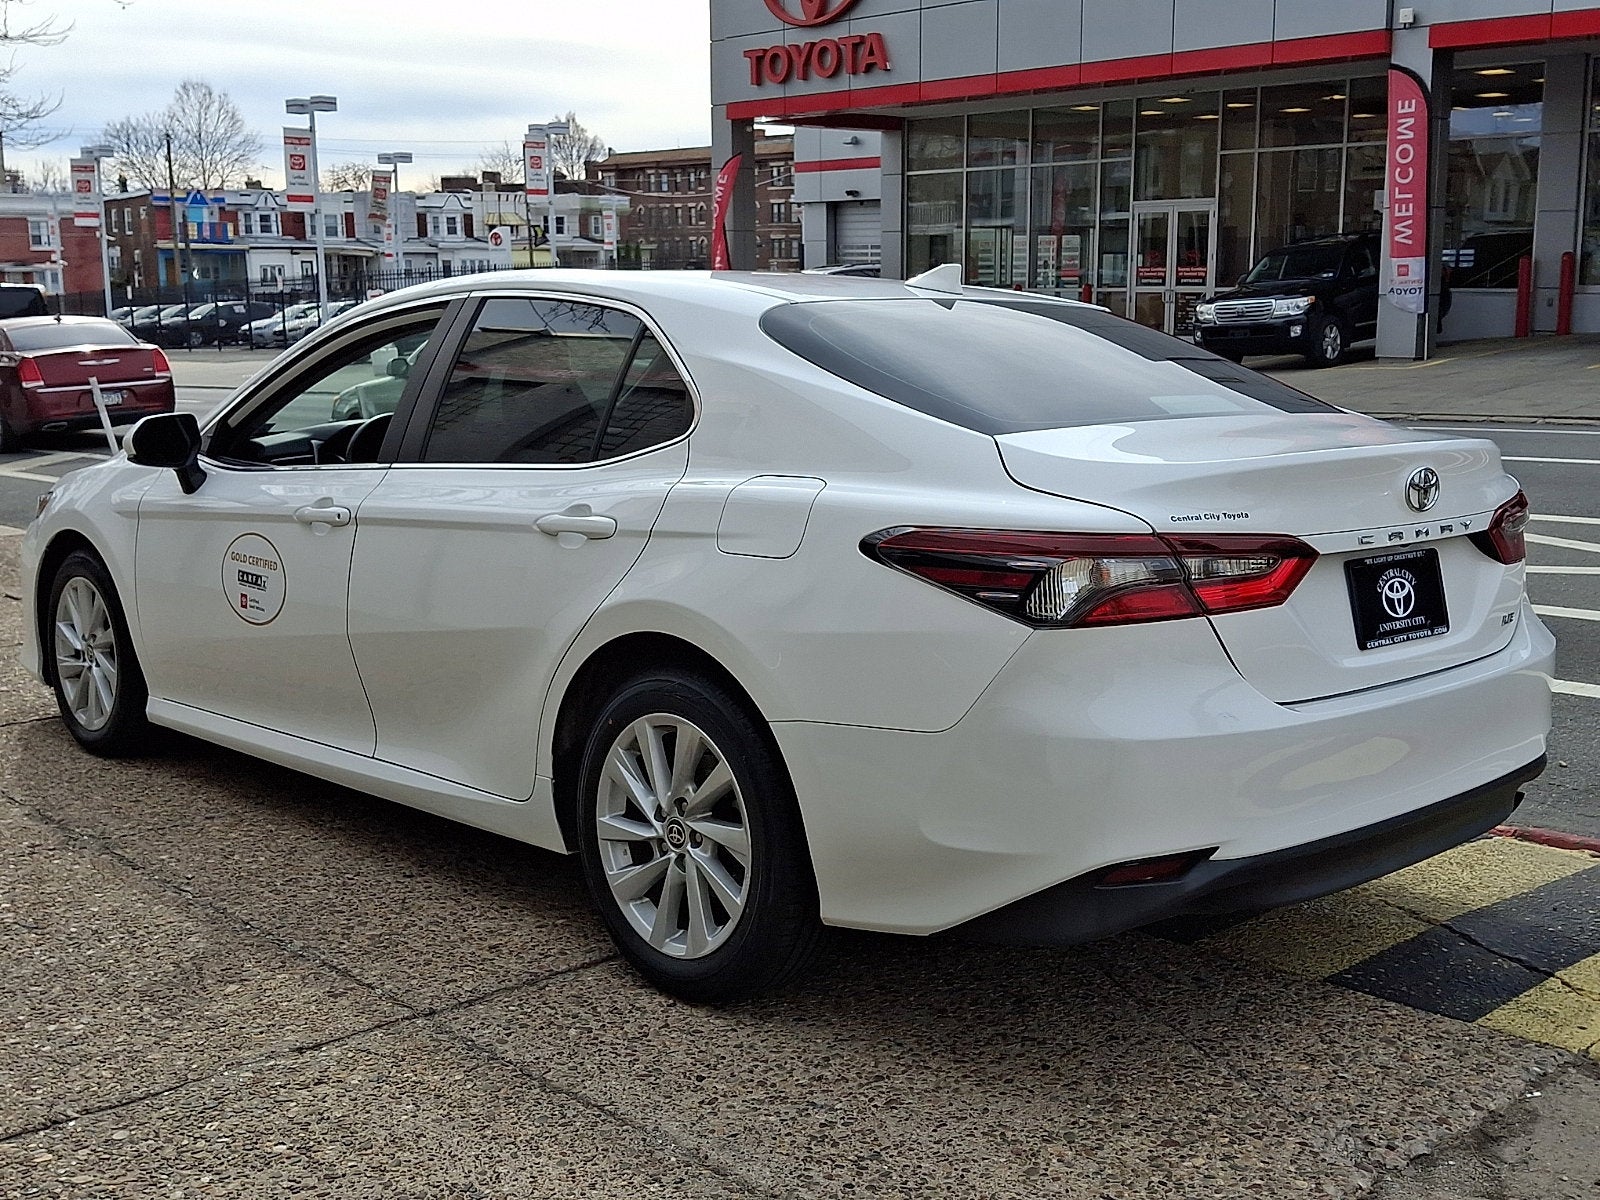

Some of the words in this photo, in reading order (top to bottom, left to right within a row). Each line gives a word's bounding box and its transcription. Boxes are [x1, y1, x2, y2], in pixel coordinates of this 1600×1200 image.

[743, 33, 890, 86] TOYOTA
[1170, 514, 1202, 522] Central
[1203, 512, 1220, 521] City
[1222, 511, 1249, 521] Toyota
[1358, 520, 1472, 545] CAMRY
[231, 551, 248, 564] GOLD
[248, 555, 278, 571] CERTIFIED
[1376, 568, 1401, 593] CENTRAL
[1401, 569, 1417, 586] CITY
[1379, 618, 1412, 633] UNIVERSITY
[1412, 616, 1426, 626] CITY
[1366, 639, 1393, 649] CENTRAL
[1393, 636, 1407, 644] CITY
[1408, 631, 1432, 641] TOYOTA
